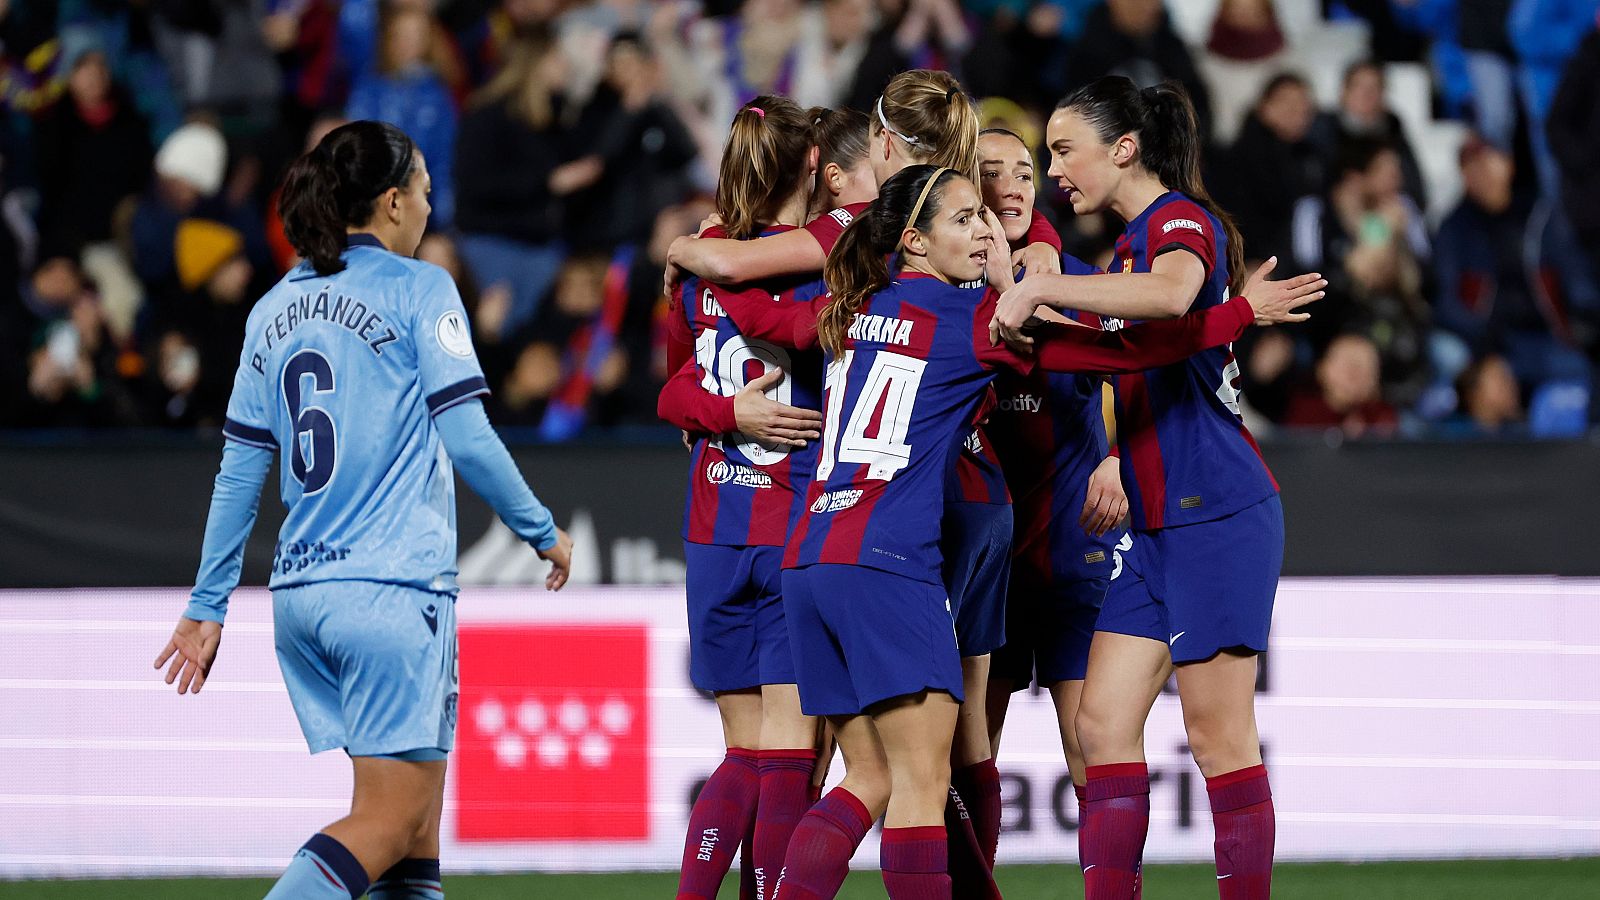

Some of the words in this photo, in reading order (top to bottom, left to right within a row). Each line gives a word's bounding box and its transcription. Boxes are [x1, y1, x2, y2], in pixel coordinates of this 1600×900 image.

[1162, 219, 1203, 235] BIMBO
[250, 352, 267, 377] P.
[264, 284, 398, 356] FERNÁNDEZ
[847, 312, 914, 346] AITANA
[816, 348, 929, 482] 14
[1000, 393, 1043, 413] otify
[282, 348, 336, 497] 6
[733, 474, 772, 485] ACNUR
[832, 489, 863, 501] UNHCR
[696, 827, 719, 862] BARÇA
[755, 867, 766, 900] BARÇA
